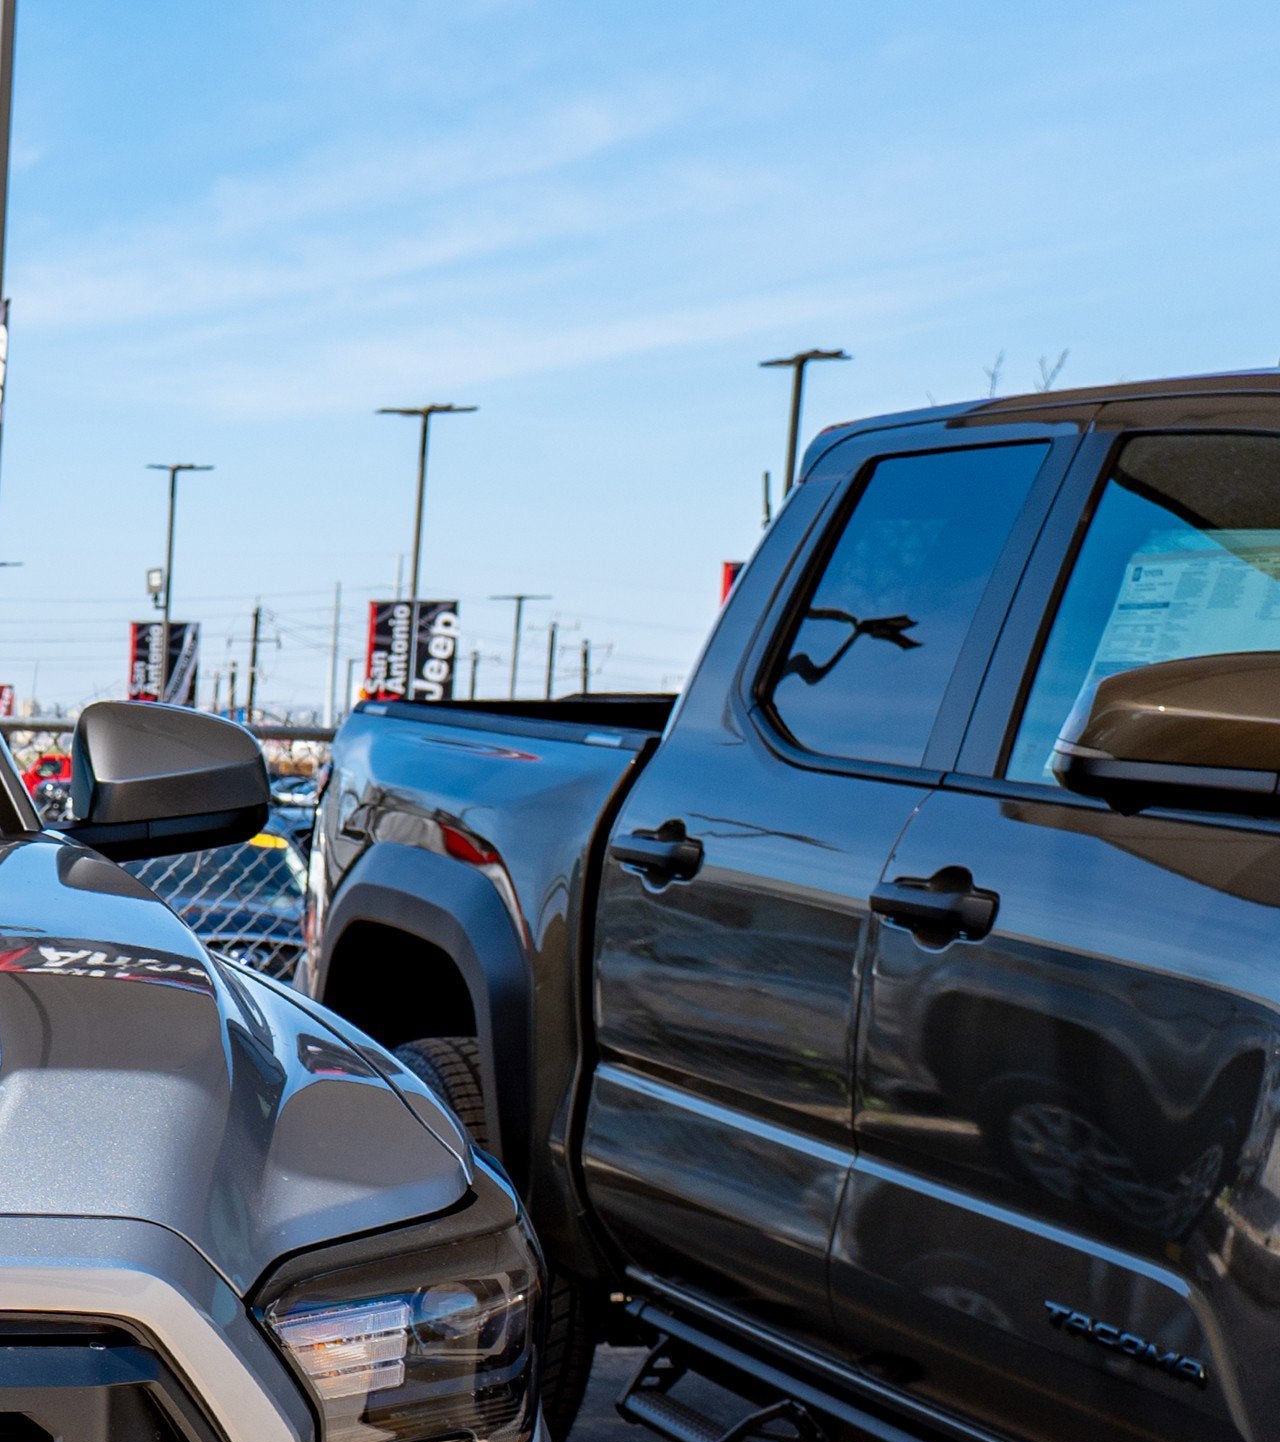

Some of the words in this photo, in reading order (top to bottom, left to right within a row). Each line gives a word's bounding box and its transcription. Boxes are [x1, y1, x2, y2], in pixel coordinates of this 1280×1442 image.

[365, 651, 388, 694] San
[384, 604, 411, 695] Antonio
[412, 611, 460, 701] Jeep
[1044, 1299, 1207, 1383] TACOMA
